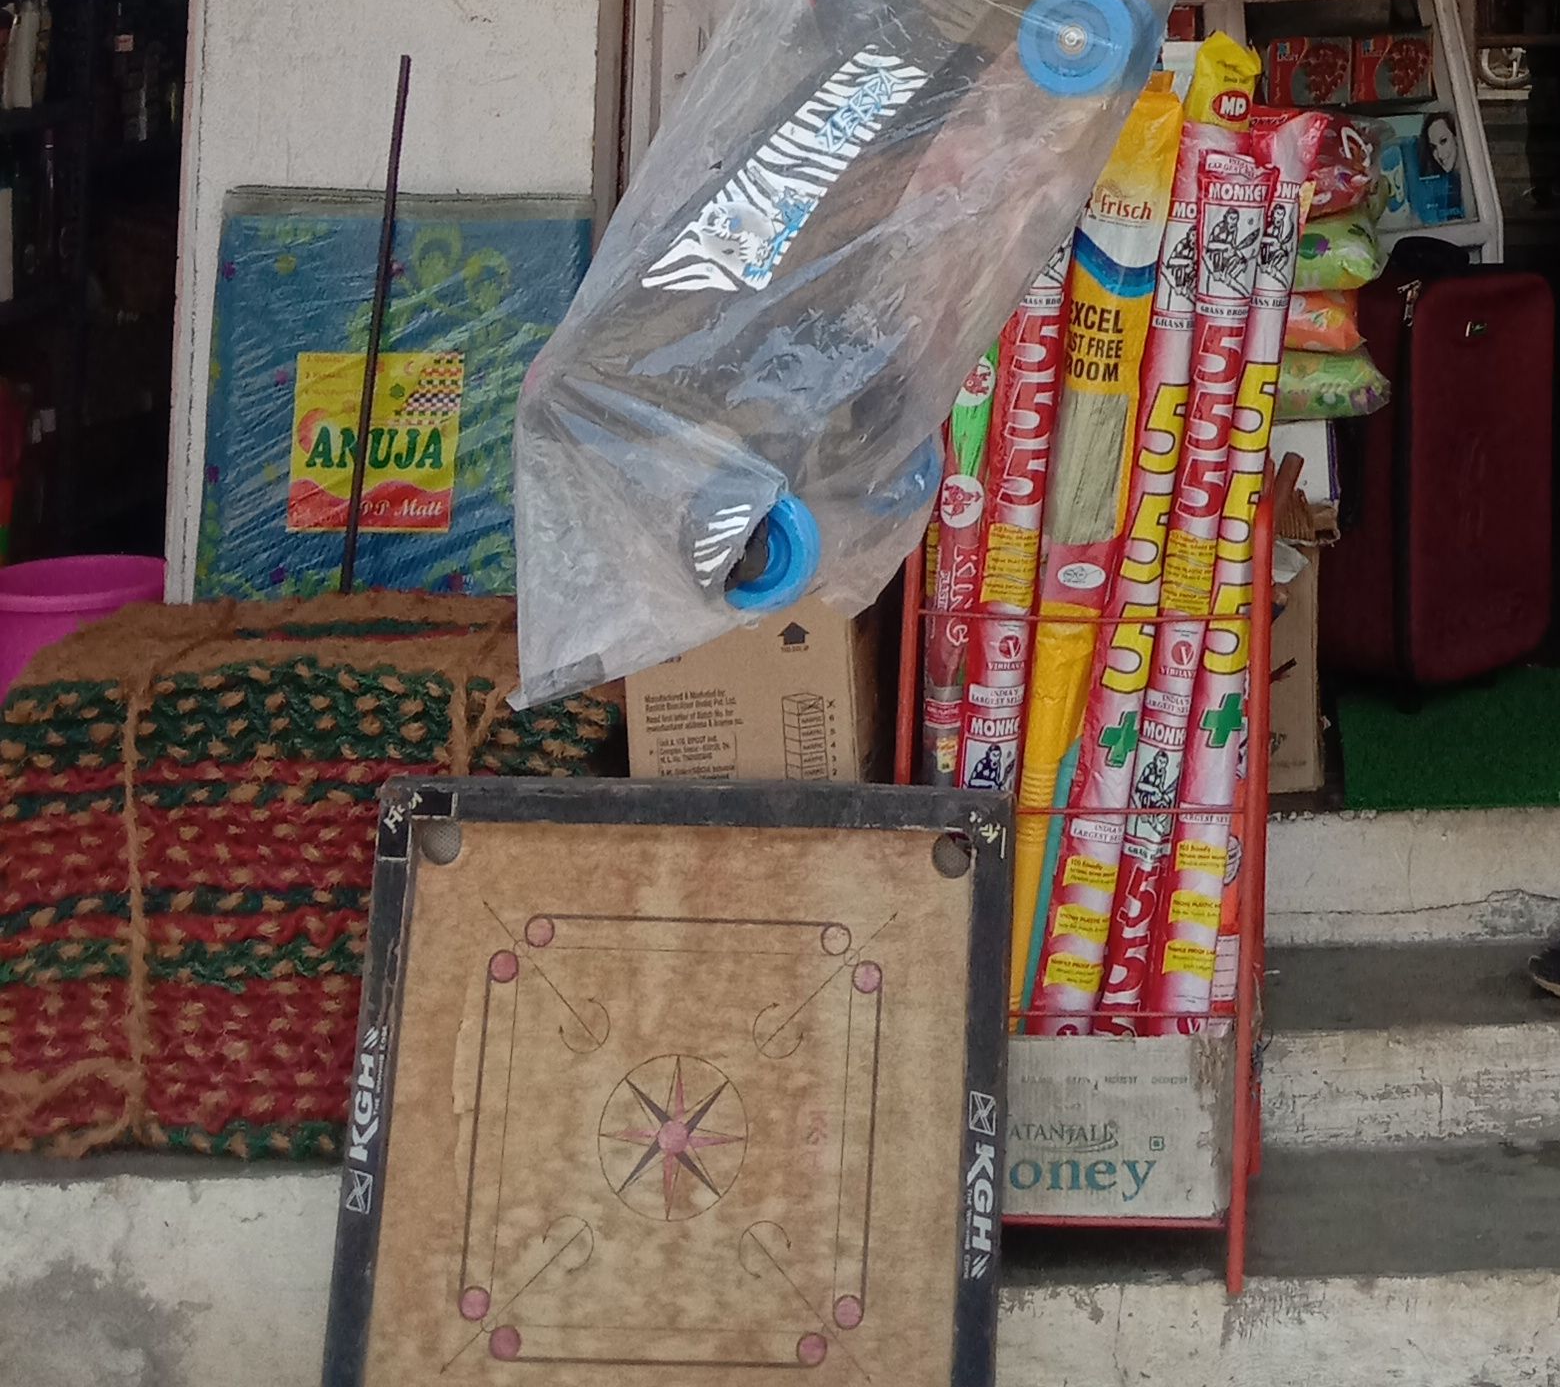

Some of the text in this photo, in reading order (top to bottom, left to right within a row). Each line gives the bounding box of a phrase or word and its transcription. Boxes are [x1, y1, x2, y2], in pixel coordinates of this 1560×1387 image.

[1086, 336, 1124, 360] FREE
[347, 1052, 380, 1163] KGH
[1008, 1120, 1119, 1147] ATANJALI
[966, 1141, 995, 1252] KGH
[1008, 1158, 1158, 1203] oney
